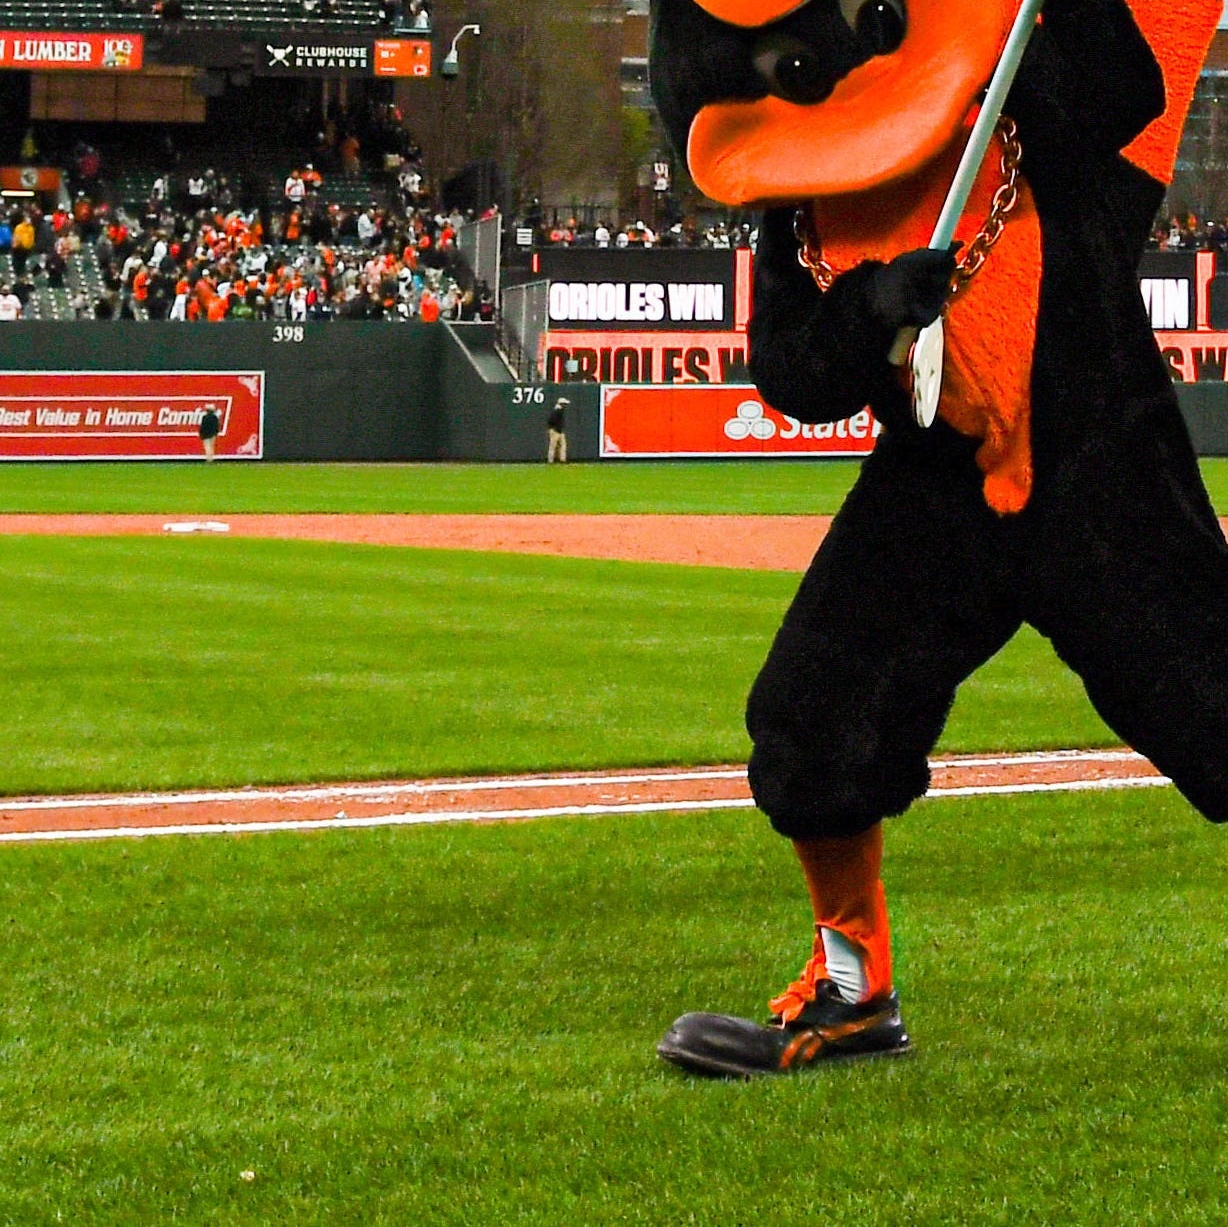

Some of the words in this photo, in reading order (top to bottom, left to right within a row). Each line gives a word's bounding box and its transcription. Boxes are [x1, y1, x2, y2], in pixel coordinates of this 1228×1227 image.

[13, 40, 91, 61] LUMBER
[296, 47, 367, 57] CLUBHOUSE
[296, 58, 367, 67] REWARDS
[550, 283, 664, 321] ORIOLES
[668, 283, 723, 321] WIN
[272, 326, 304, 342] 398
[512, 387, 545, 403] 376
[36, 408, 79, 426] Value
[85, 408, 101, 425] in
[105, 408, 152, 425] Home
[157, 407, 222, 425] Comft
